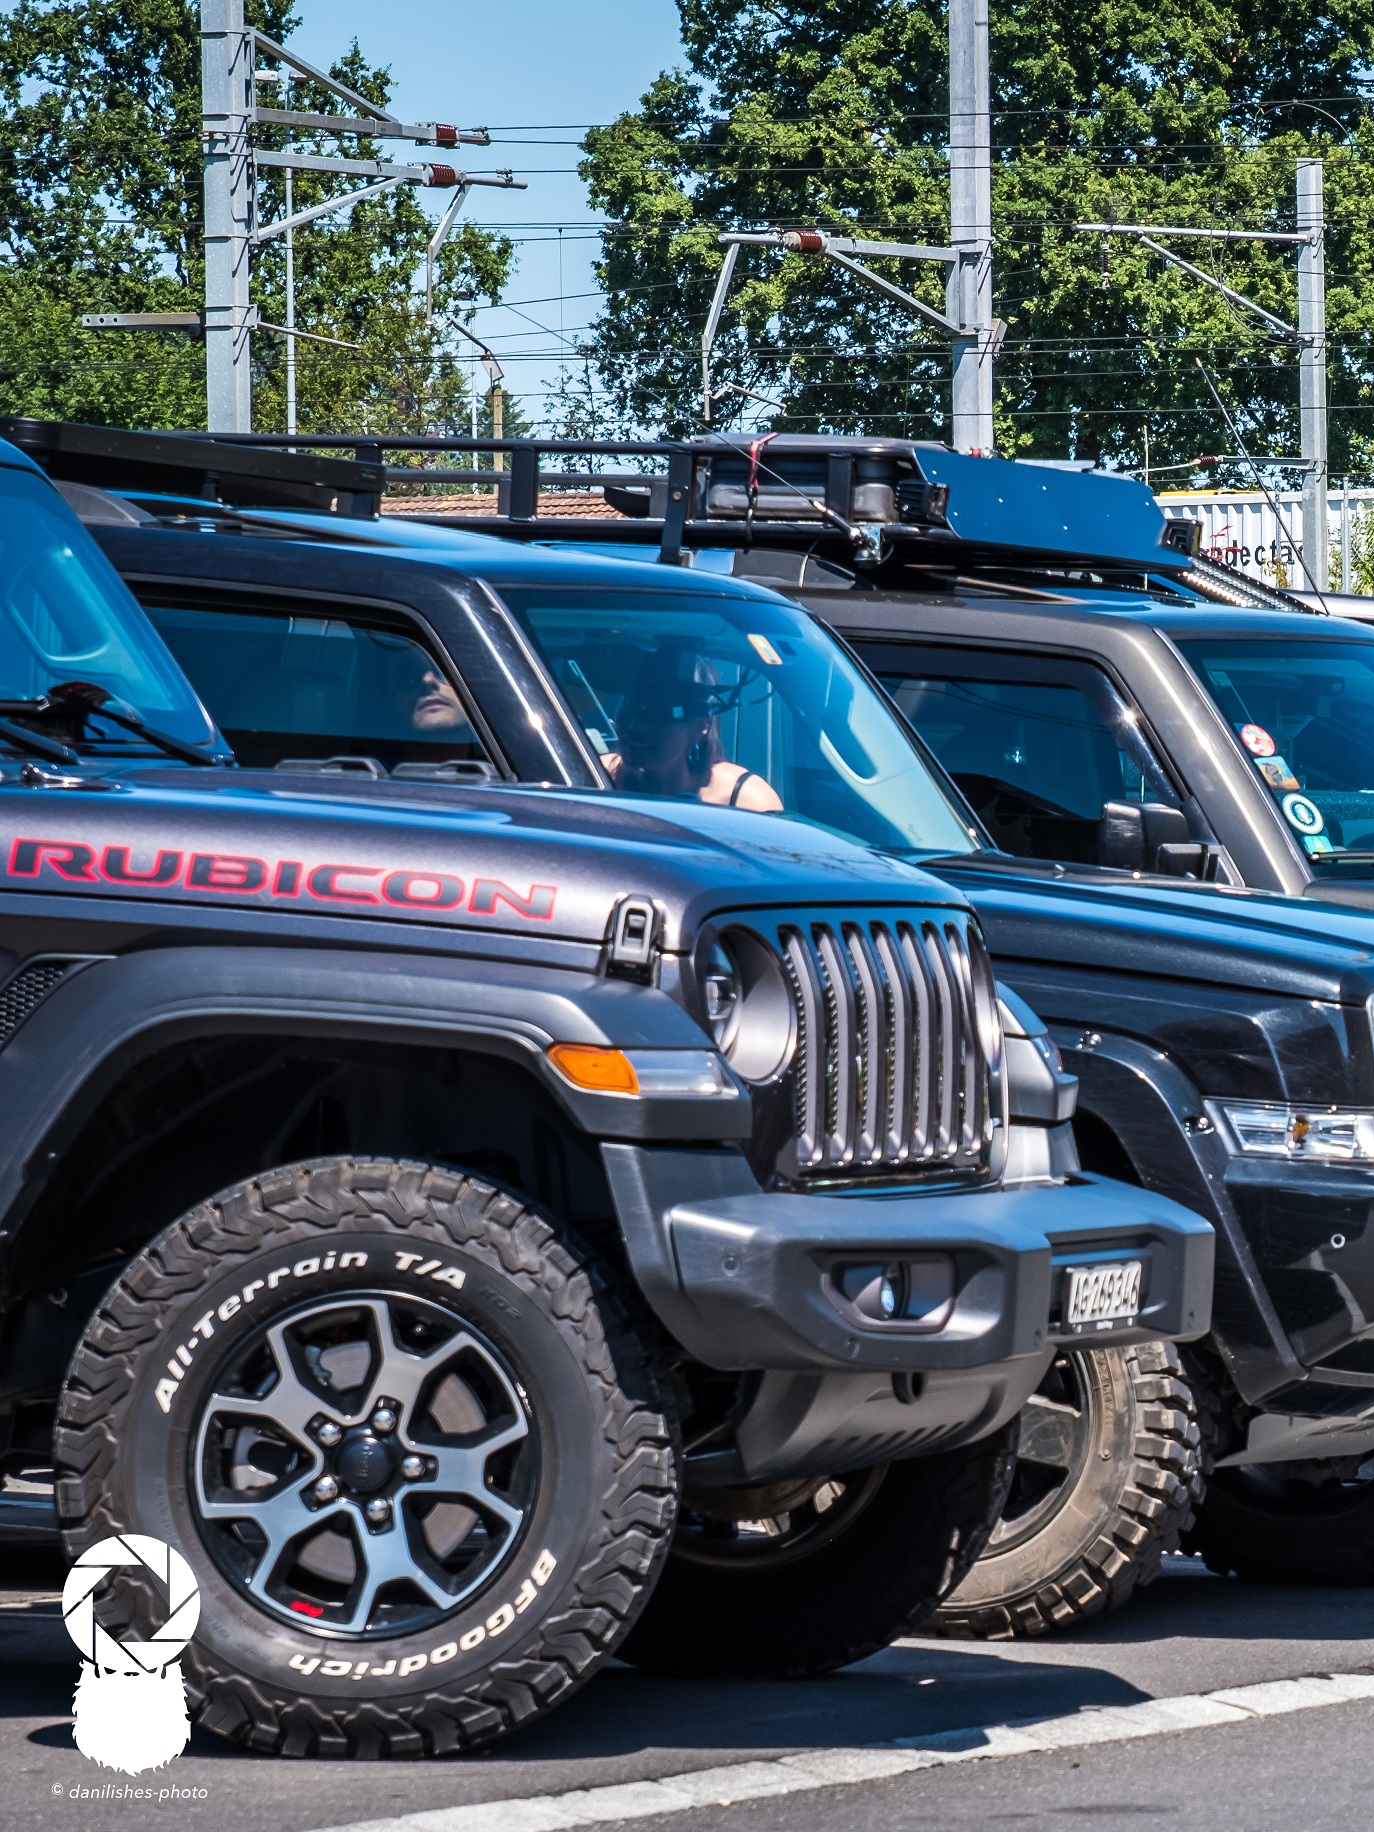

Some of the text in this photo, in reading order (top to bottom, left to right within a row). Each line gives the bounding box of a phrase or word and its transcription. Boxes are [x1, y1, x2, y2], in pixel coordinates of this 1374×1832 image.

[7, 838, 559, 921] RUBICON
[155, 1251, 368, 1414] All-Terrain
[395, 1250, 468, 1291] T/A
[288, 1548, 556, 1681] BFGoodrich
